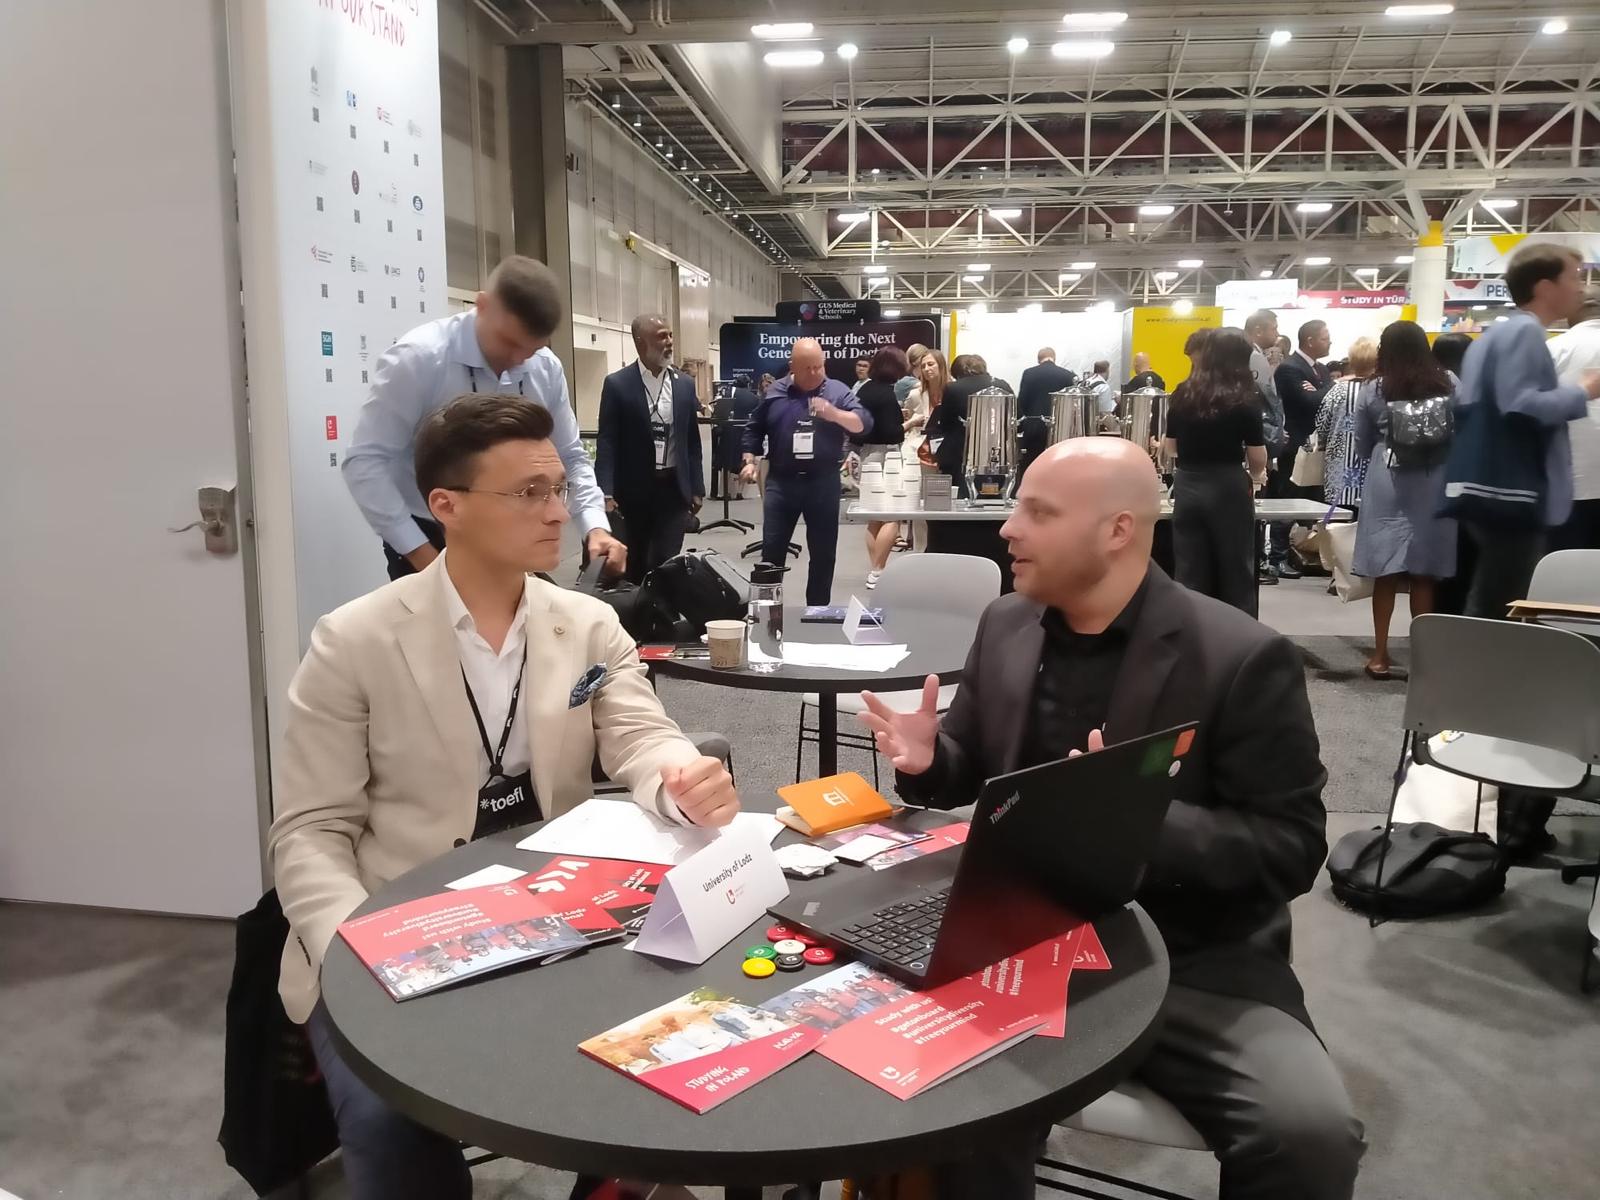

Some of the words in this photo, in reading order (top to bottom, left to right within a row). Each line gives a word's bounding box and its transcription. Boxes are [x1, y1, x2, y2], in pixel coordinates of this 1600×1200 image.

[370, 1, 405, 47] STAND
[825, 308, 856, 316] Veterinary
[1340, 295, 1372, 304] STUDY
[1374, 296, 1384, 304] IN
[760, 333, 842, 348] Emporing
[845, 334, 865, 345] the
[868, 333, 896, 345] Next
[834, 347, 847, 359] of
[490, 786, 524, 812] toefl
[990, 790, 1020, 824] ThinkPad
[702, 868, 733, 892] University
[732, 860, 739, 872] of
[738, 853, 752, 868] Lodz
[902, 1000, 985, 1038] #universitydiversity
[914, 1013, 977, 1045] #freeyourmind
[685, 1065, 729, 1089] STUDYING
[705, 1083, 719, 1092] IN
[716, 1066, 750, 1086] POLAND
